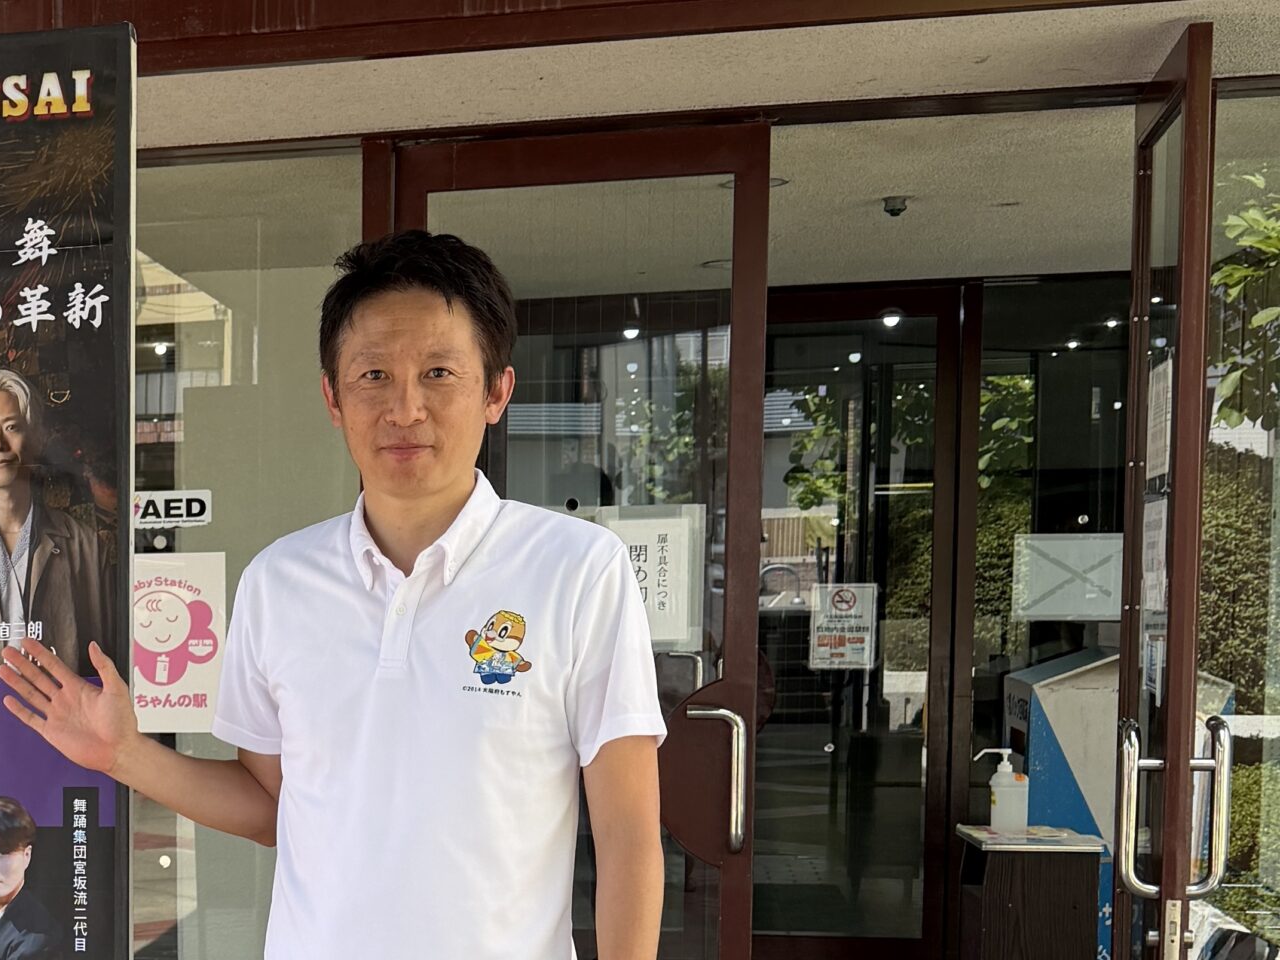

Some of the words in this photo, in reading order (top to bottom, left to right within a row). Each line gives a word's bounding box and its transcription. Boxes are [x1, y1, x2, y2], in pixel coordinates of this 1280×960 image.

[140, 497, 207, 519] AED
[656, 533, 669, 611] 扉不具合につき
[72, 798, 89, 952] 舞踊集団宮坂流二代目
